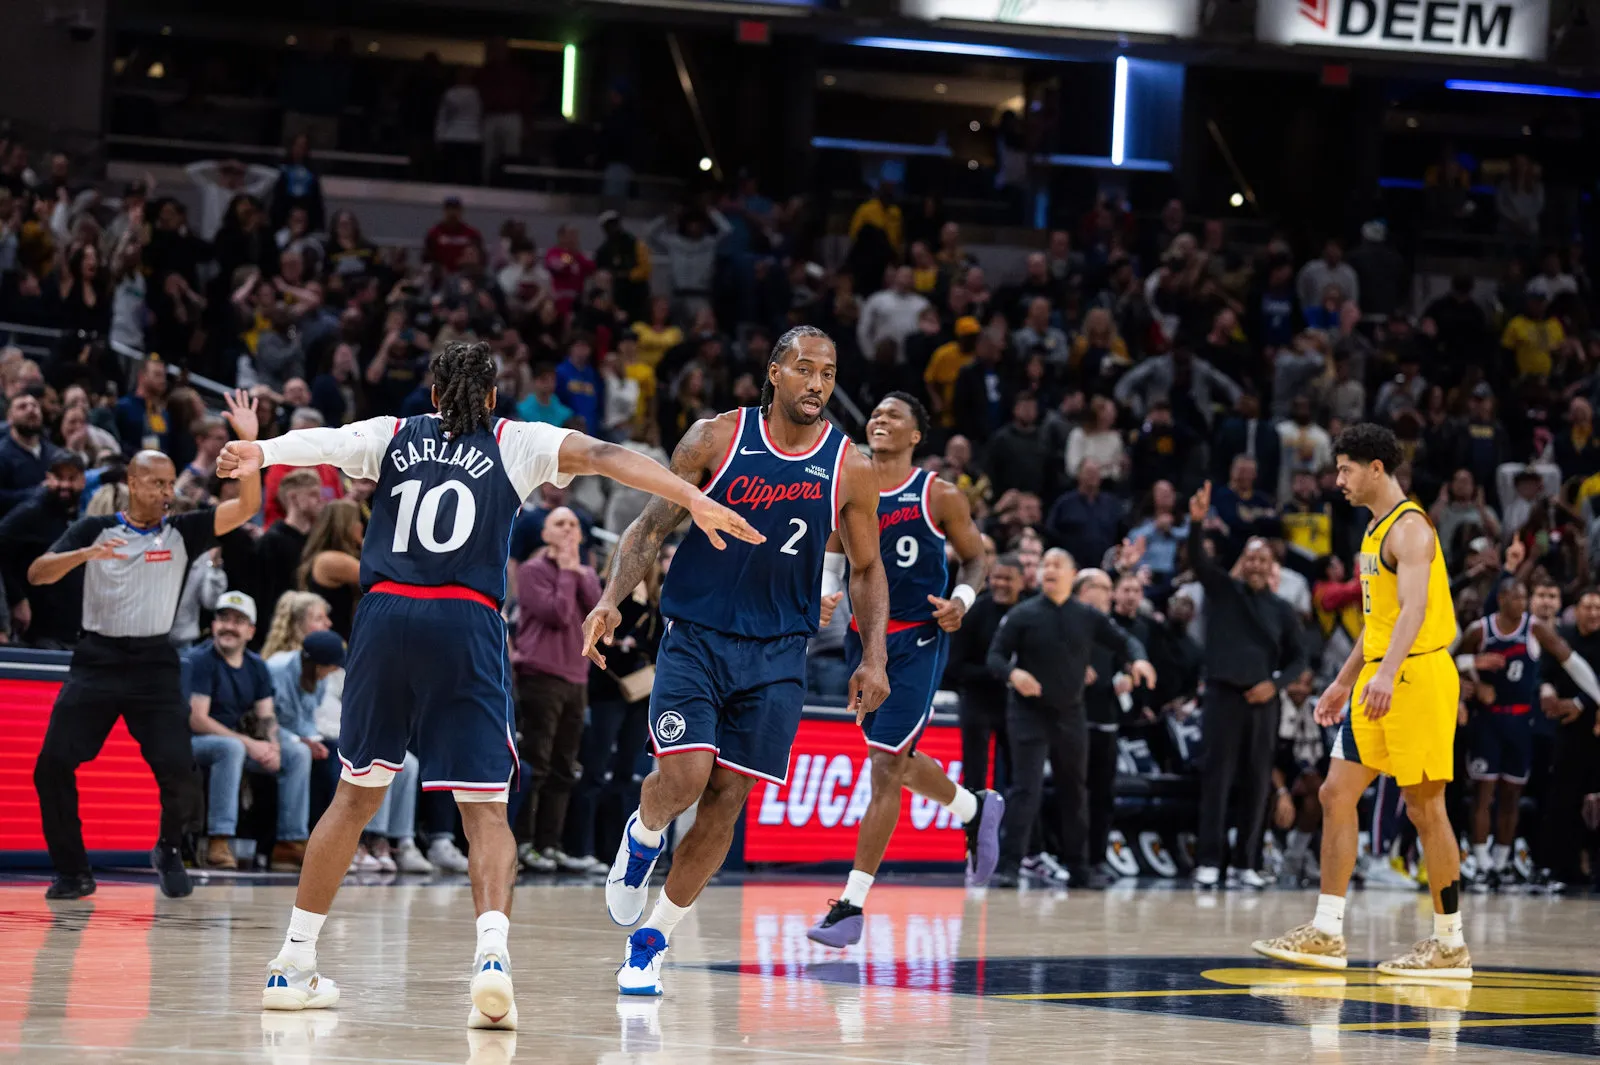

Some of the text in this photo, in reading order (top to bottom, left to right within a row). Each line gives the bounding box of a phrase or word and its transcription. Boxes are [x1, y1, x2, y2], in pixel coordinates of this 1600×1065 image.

[1337, 0, 1512, 47] DEEM
[390, 438, 494, 479] GARLAND
[804, 466, 830, 480] RWANDA
[811, 464, 826, 473] VISIT
[726, 475, 823, 510] Clippers
[390, 479, 476, 553] 10
[879, 504, 922, 536] pers
[780, 518, 808, 555] 2
[895, 535, 919, 567] 9
[758, 754, 872, 828] LUCA
